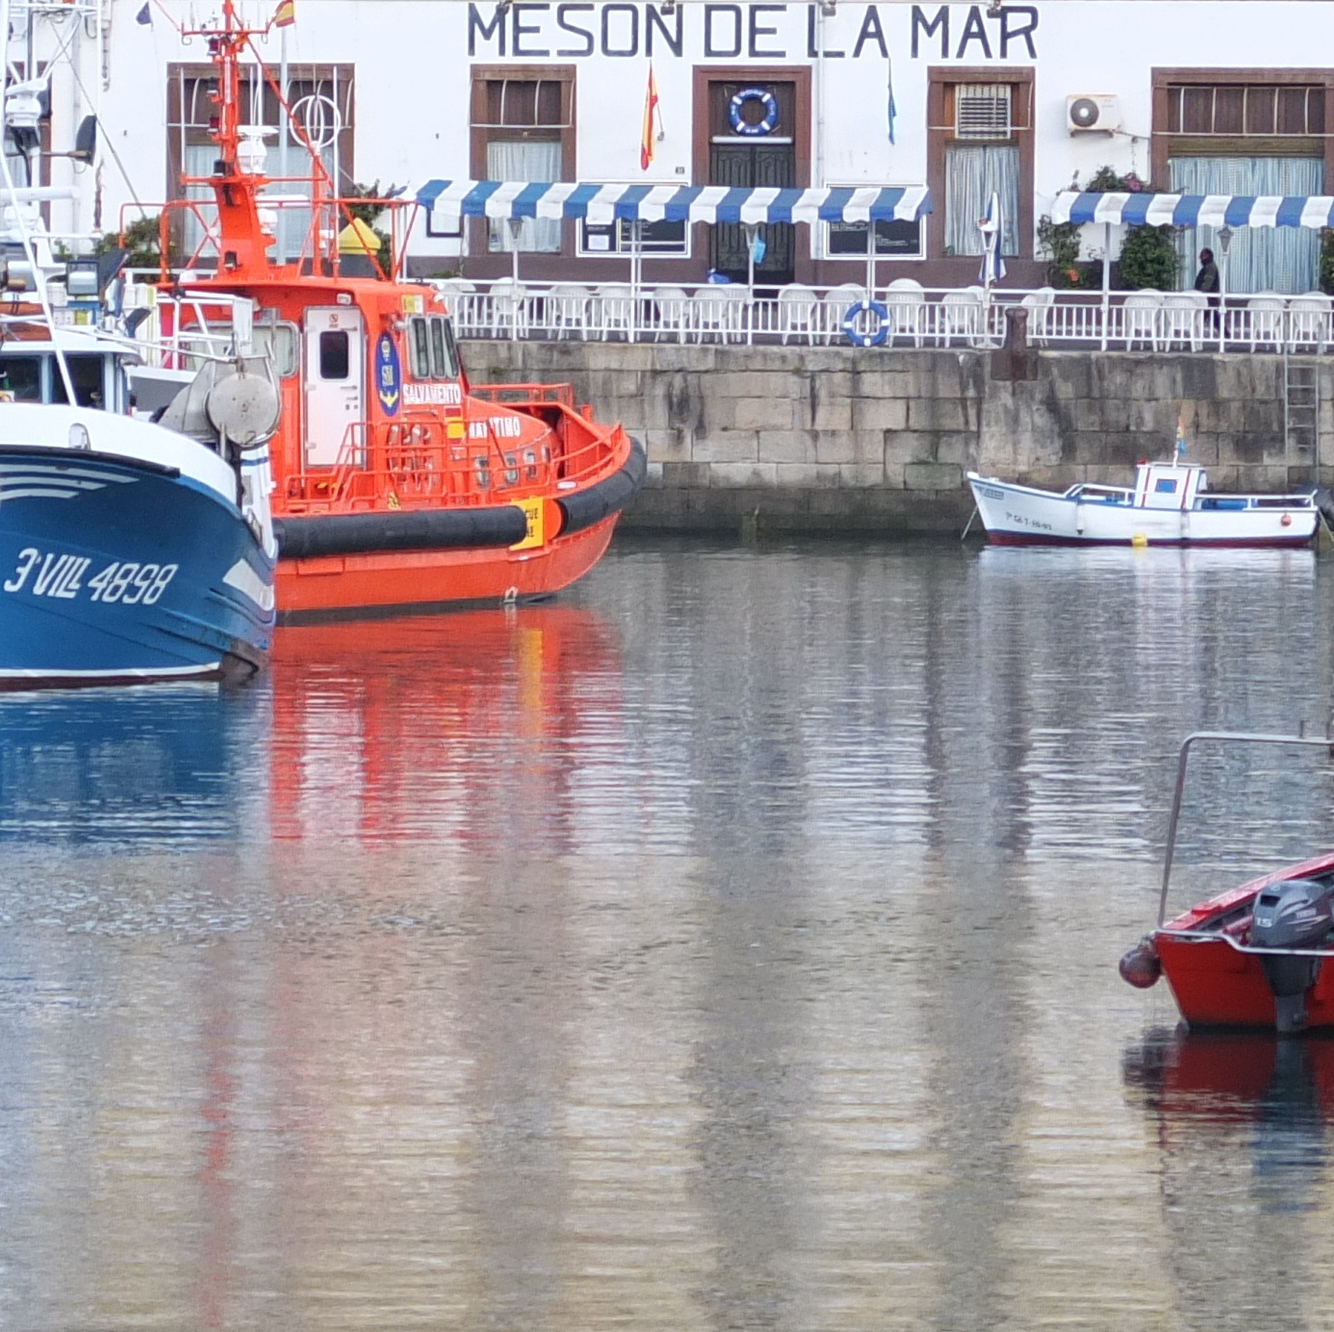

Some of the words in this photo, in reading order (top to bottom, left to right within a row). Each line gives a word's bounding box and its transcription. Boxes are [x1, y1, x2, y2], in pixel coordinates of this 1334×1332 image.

[467, 2, 684, 57] MESON
[703, 4, 788, 58] DE
[807, 4, 890, 58] LA
[911, 4, 1040, 59] MAR
[402, 382, 462, 406] SALVAMENTO
[87, 561, 179, 606] 4898
